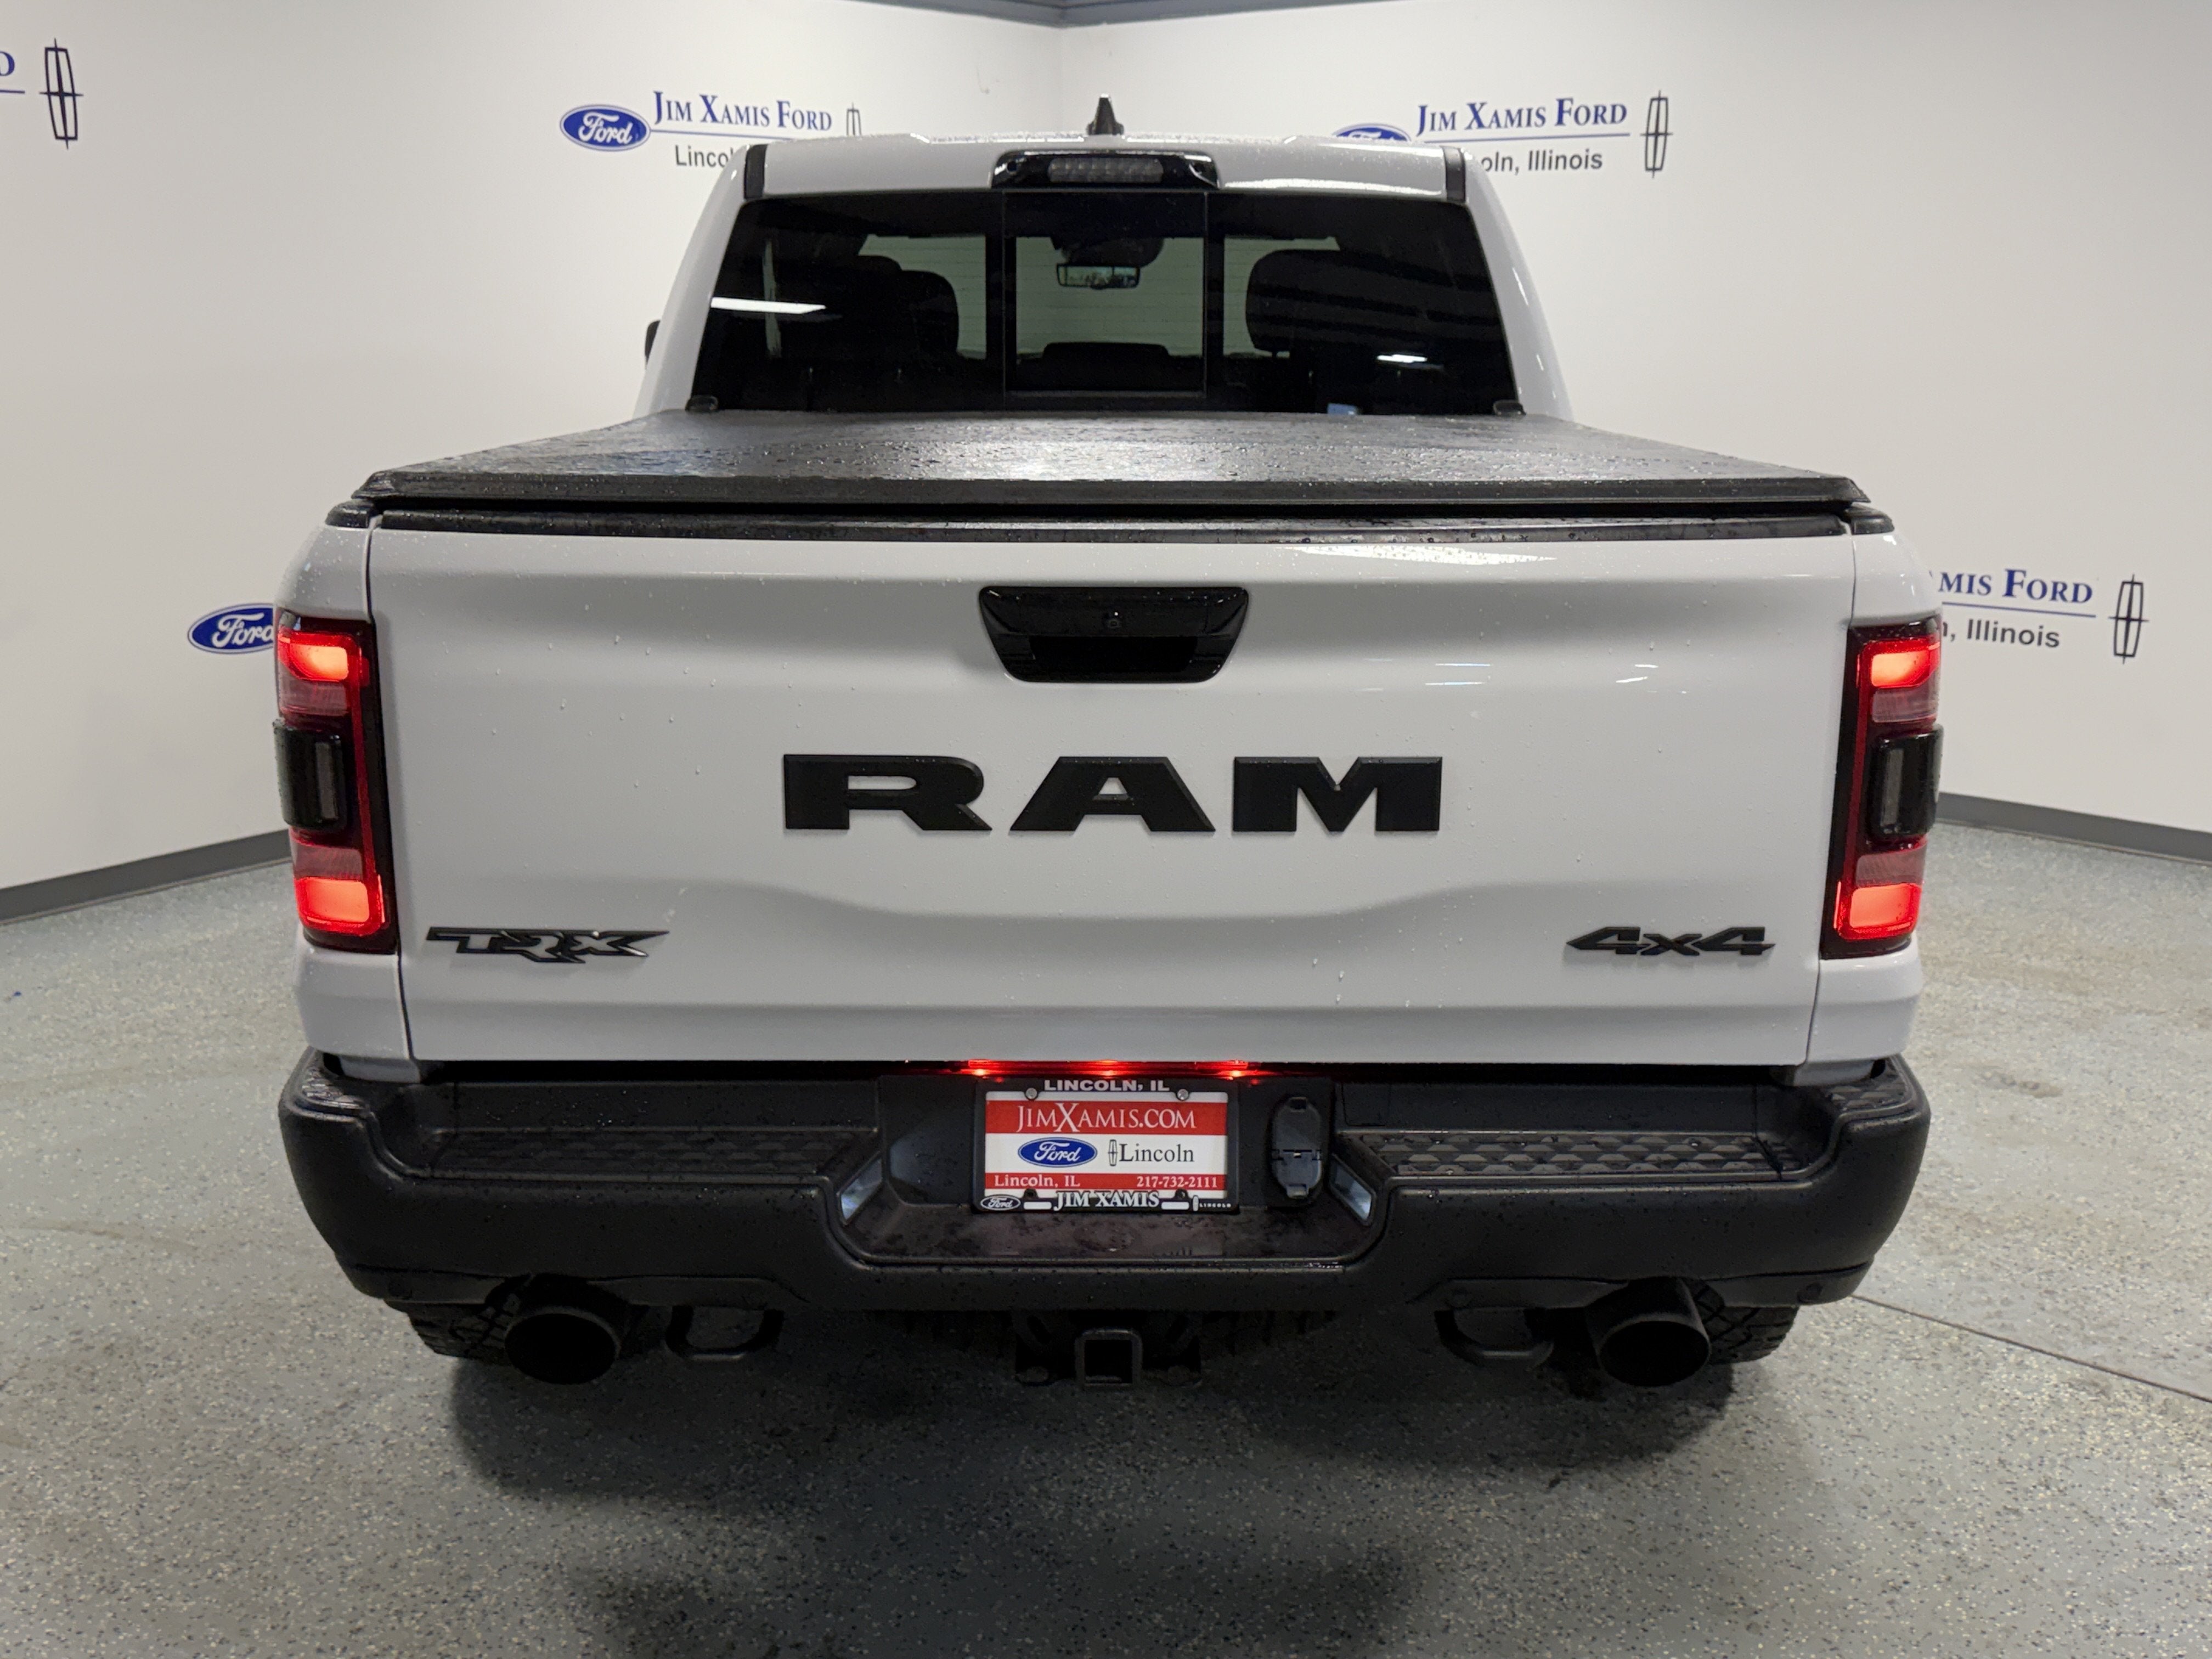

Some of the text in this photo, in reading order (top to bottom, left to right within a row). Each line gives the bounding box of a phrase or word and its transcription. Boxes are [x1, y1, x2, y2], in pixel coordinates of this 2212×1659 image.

[653, 91, 832, 132] JIM XAMIS FORD
[1417, 98, 1627, 137] JIM XAMIS FORD
[578, 111, 633, 144] Ford
[675, 144, 733, 167] Linco
[1528, 149, 1602, 171] Illinois
[1929, 568, 2093, 603] MIS FORD
[1967, 619, 2060, 648] Illinois
[783, 754, 1442, 832] RAM
[426, 927, 670, 963] TRX
[1044, 1079, 1170, 1092] LINCOLN, IL
[1016, 1102, 1197, 1132] JIMXAMIS.COM
[1034, 1141, 1081, 1162] Ford
[1119, 1143, 1194, 1163] Lincoln
[994, 1174, 1080, 1188] Lincoln, IL
[1136, 1176, 1217, 1188] 217-732-2111
[988, 1197, 1013, 1208] Ford
[1053, 1190, 1160, 1211] JIM XAMIS
